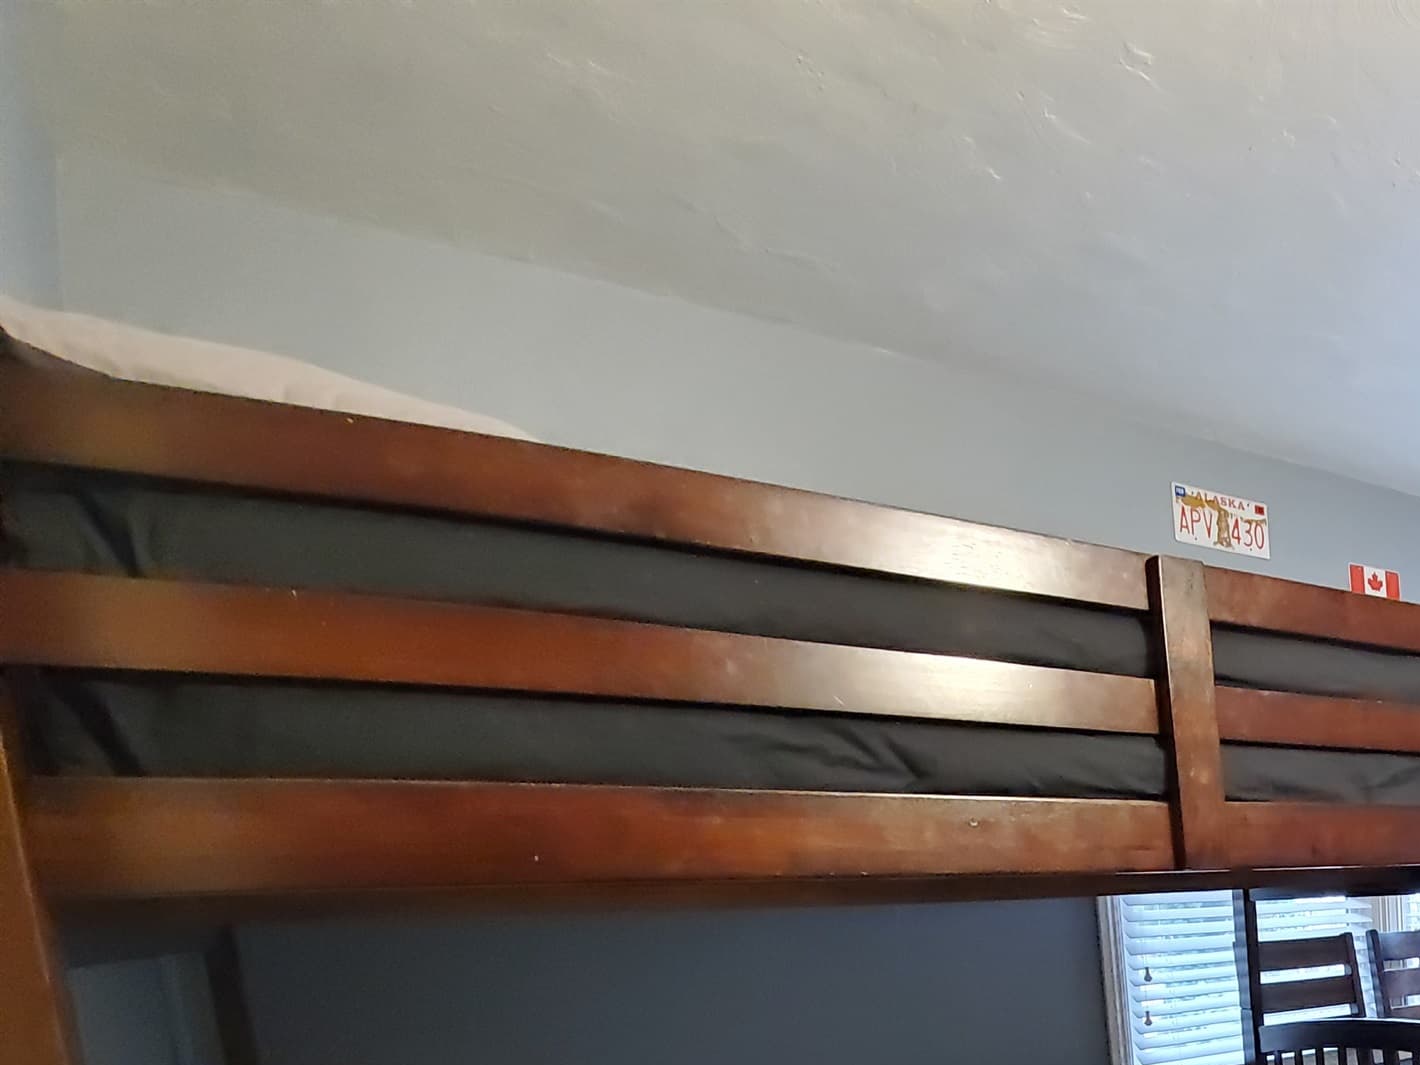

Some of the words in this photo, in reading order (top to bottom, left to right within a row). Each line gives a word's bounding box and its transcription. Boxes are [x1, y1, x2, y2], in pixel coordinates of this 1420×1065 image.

[1196, 491, 1245, 511] ALASKA
[1179, 504, 1213, 539] APV
[1231, 517, 1265, 550] 430
